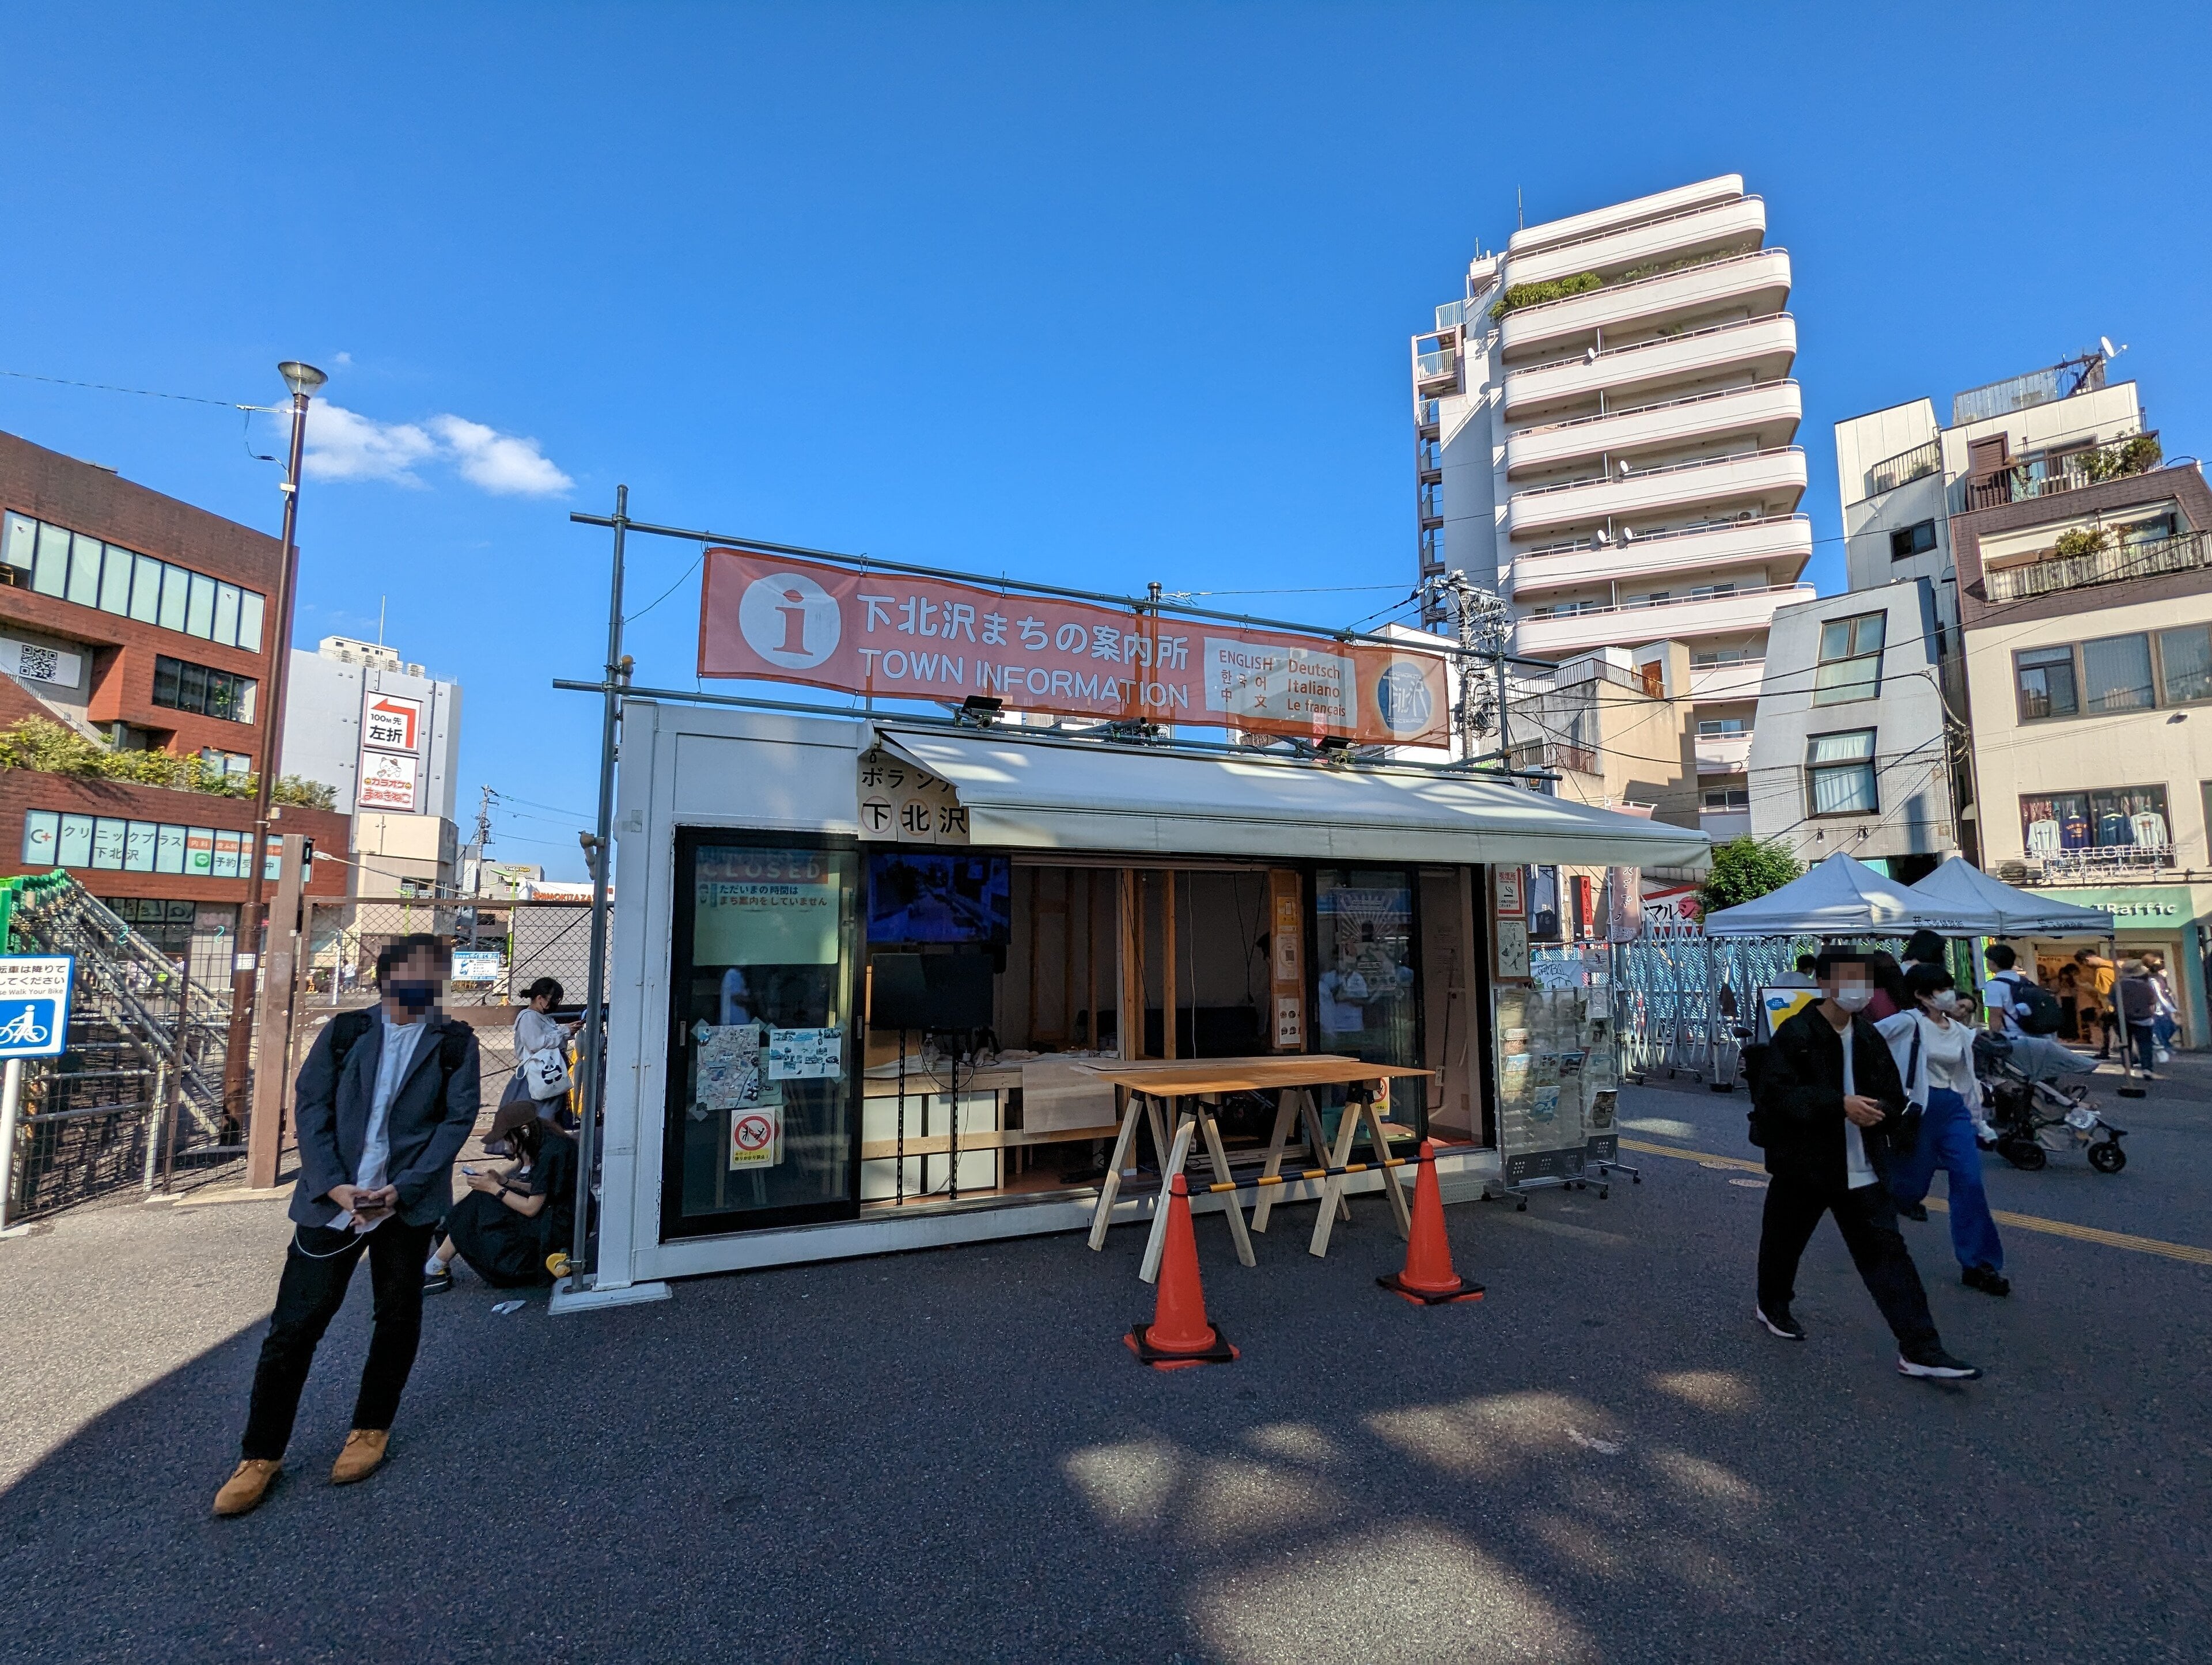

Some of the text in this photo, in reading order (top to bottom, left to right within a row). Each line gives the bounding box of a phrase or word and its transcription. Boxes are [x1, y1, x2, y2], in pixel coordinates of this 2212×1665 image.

[857, 593, 1189, 670] 下北沢まちの案内所
[1219, 650, 1273, 671] ENGLISH
[1288, 659, 1340, 680] Deutsch
[858, 647, 1188, 709] TOWN INFORMATION
[1221, 669, 1267, 691] 한국어
[1288, 678, 1340, 698] Italiano
[1287, 698, 1346, 717] Le français
[369, 725, 402, 743] 左折
[372, 777, 405, 788] カラオケ
[363, 787, 411, 804] まねきねこ
[862, 803, 967, 834] 下北沢
[64, 825, 181, 847] クリニックプラス
[96, 847, 139, 861] 下北沢
[702, 861, 821, 879] CLOSED
[532, 891, 594, 901] SHIMOKITAZA
[720, 885, 798, 895] ただいまの時間は
[719, 896, 828, 907] まち案内をしていません
